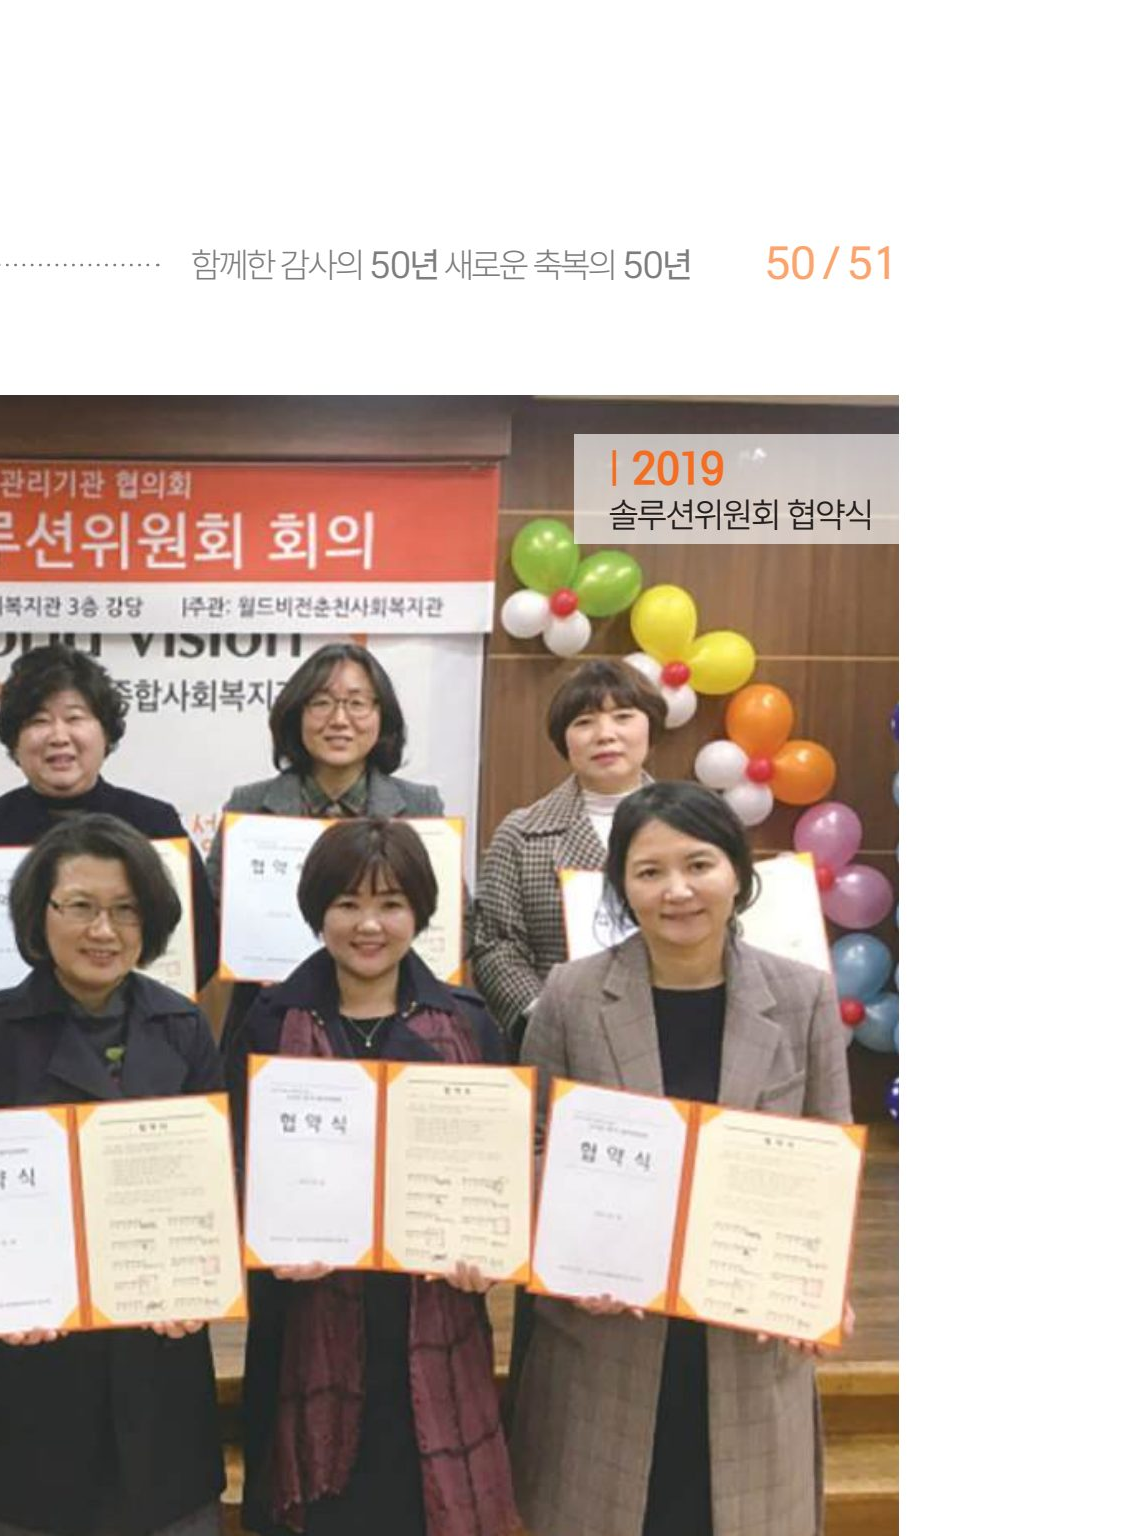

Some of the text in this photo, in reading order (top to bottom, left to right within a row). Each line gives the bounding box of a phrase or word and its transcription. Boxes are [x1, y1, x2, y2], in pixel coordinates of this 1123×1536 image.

[115, 469, 193, 500] 협의회
[269, 511, 375, 570] 회의
[68, 597, 98, 618] 3층
[107, 596, 143, 618] 강당
[238, 597, 444, 618] 월드비전춘천사회복지관
